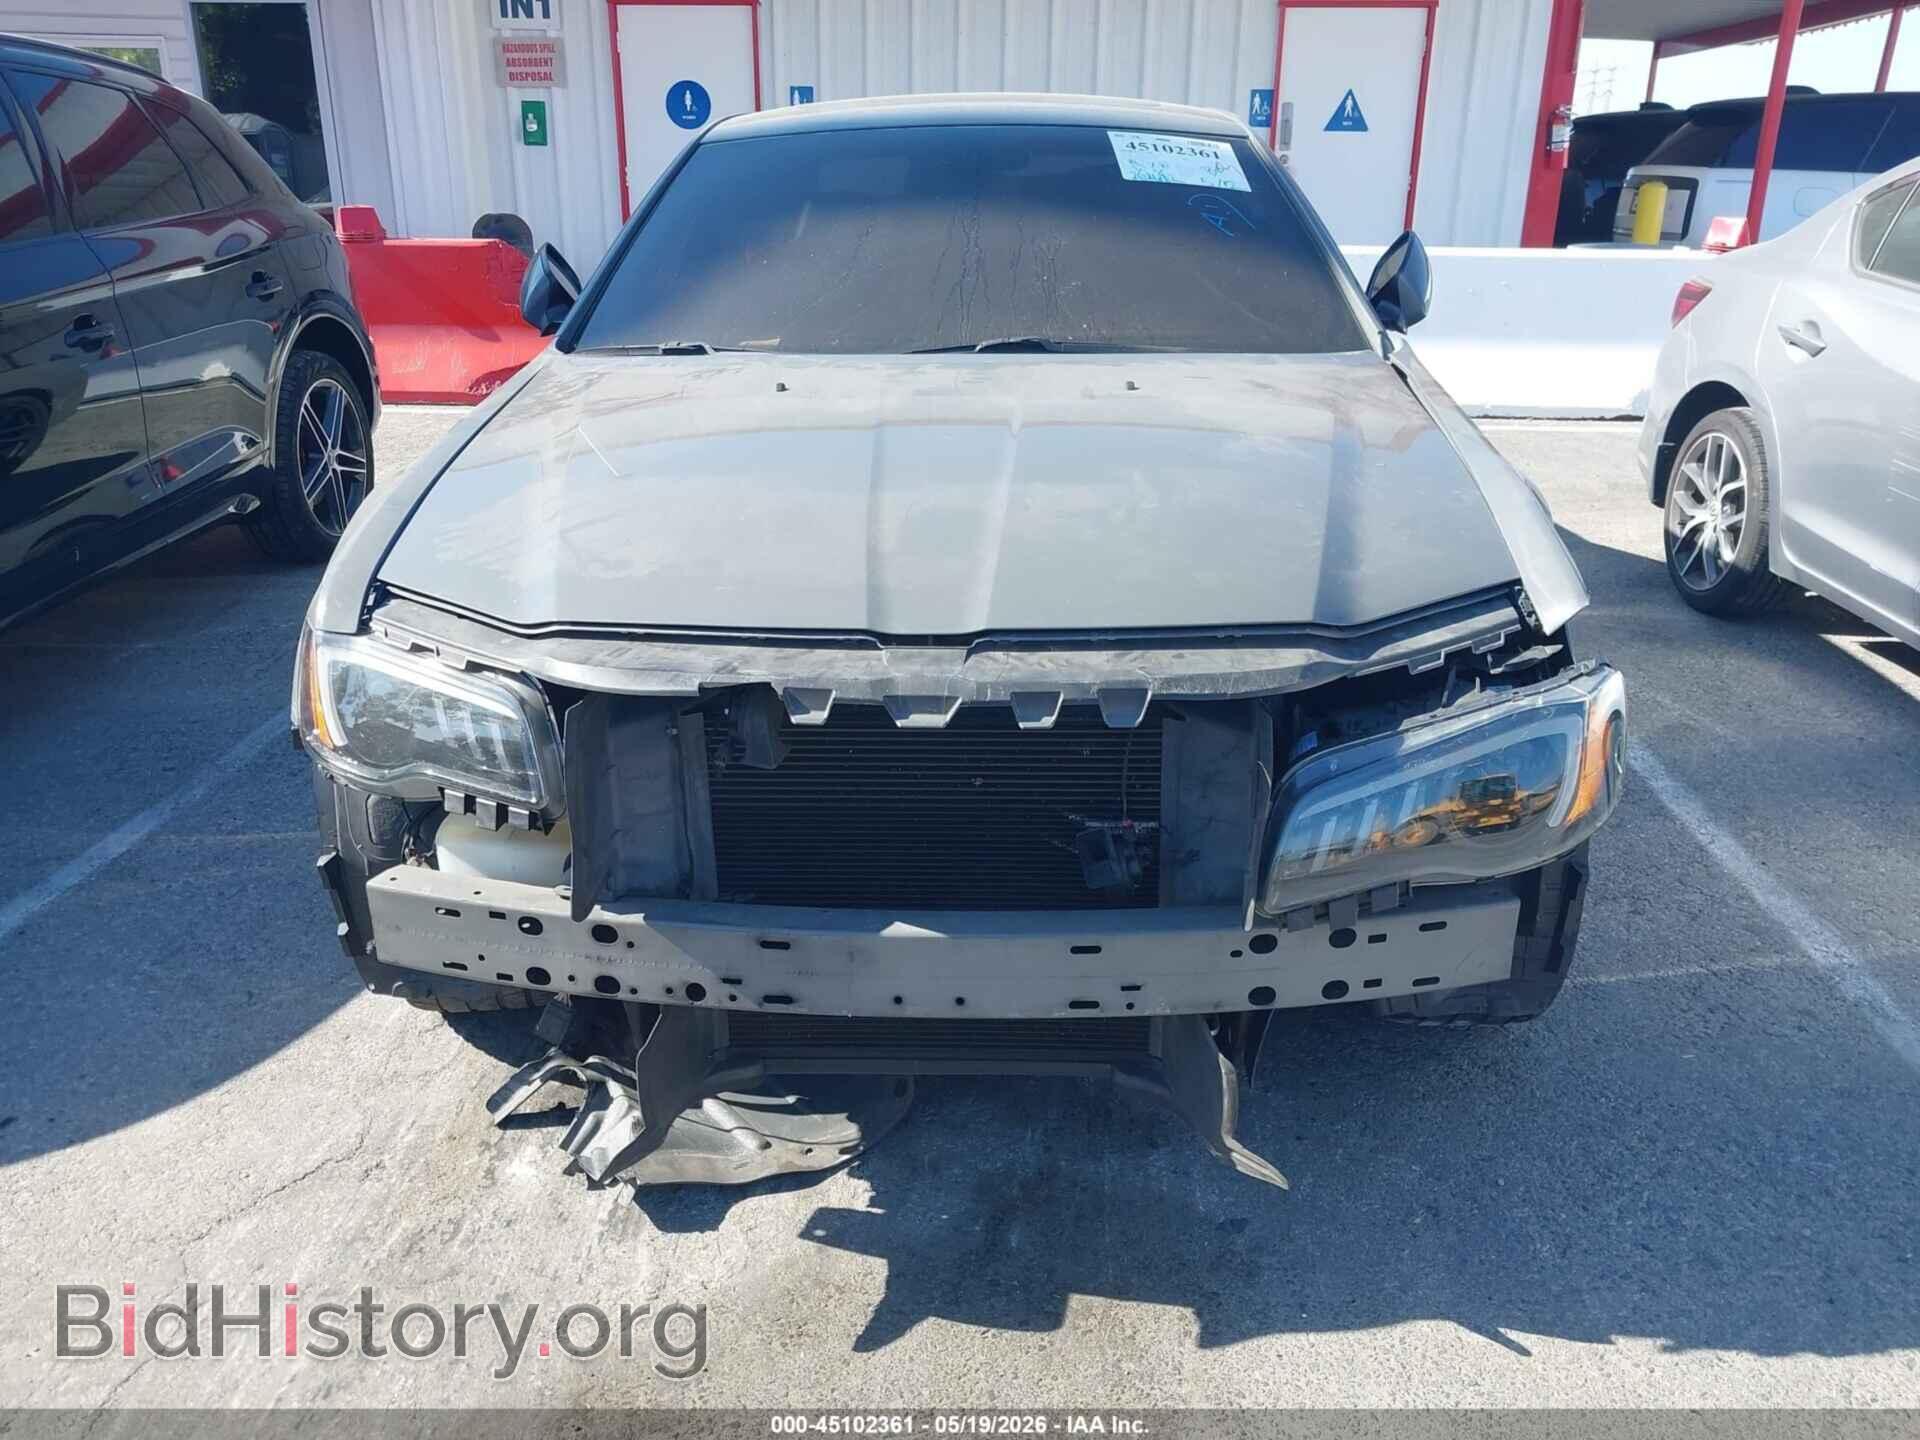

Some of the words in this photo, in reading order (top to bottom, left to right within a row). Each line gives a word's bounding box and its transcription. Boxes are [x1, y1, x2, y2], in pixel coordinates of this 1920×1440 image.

[505, 57, 553, 67] ABSORBENT
[508, 71, 553, 81] DISPOSAL
[1125, 141, 1219, 159] 45102361
